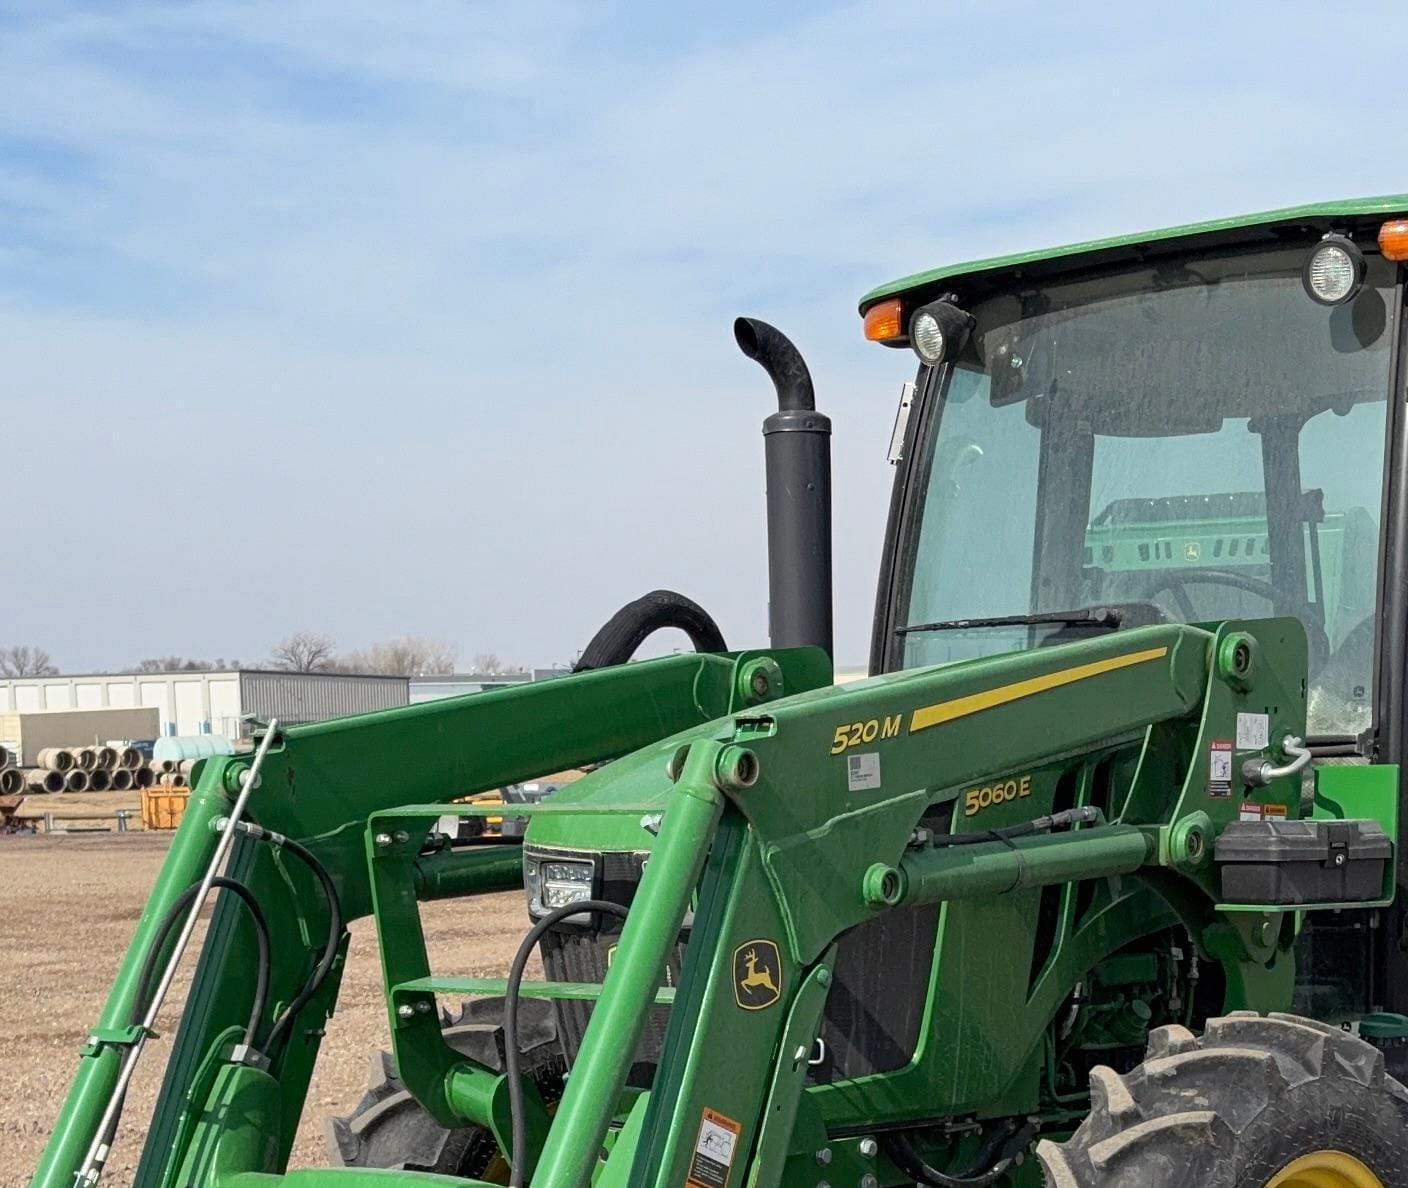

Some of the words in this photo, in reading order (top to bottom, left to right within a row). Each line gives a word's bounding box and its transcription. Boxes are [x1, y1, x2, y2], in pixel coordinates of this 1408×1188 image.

[831, 719, 879, 754] 520
[881, 714, 902, 740] M
[965, 779, 1017, 816] 5060
[1020, 775, 1032, 797] E
